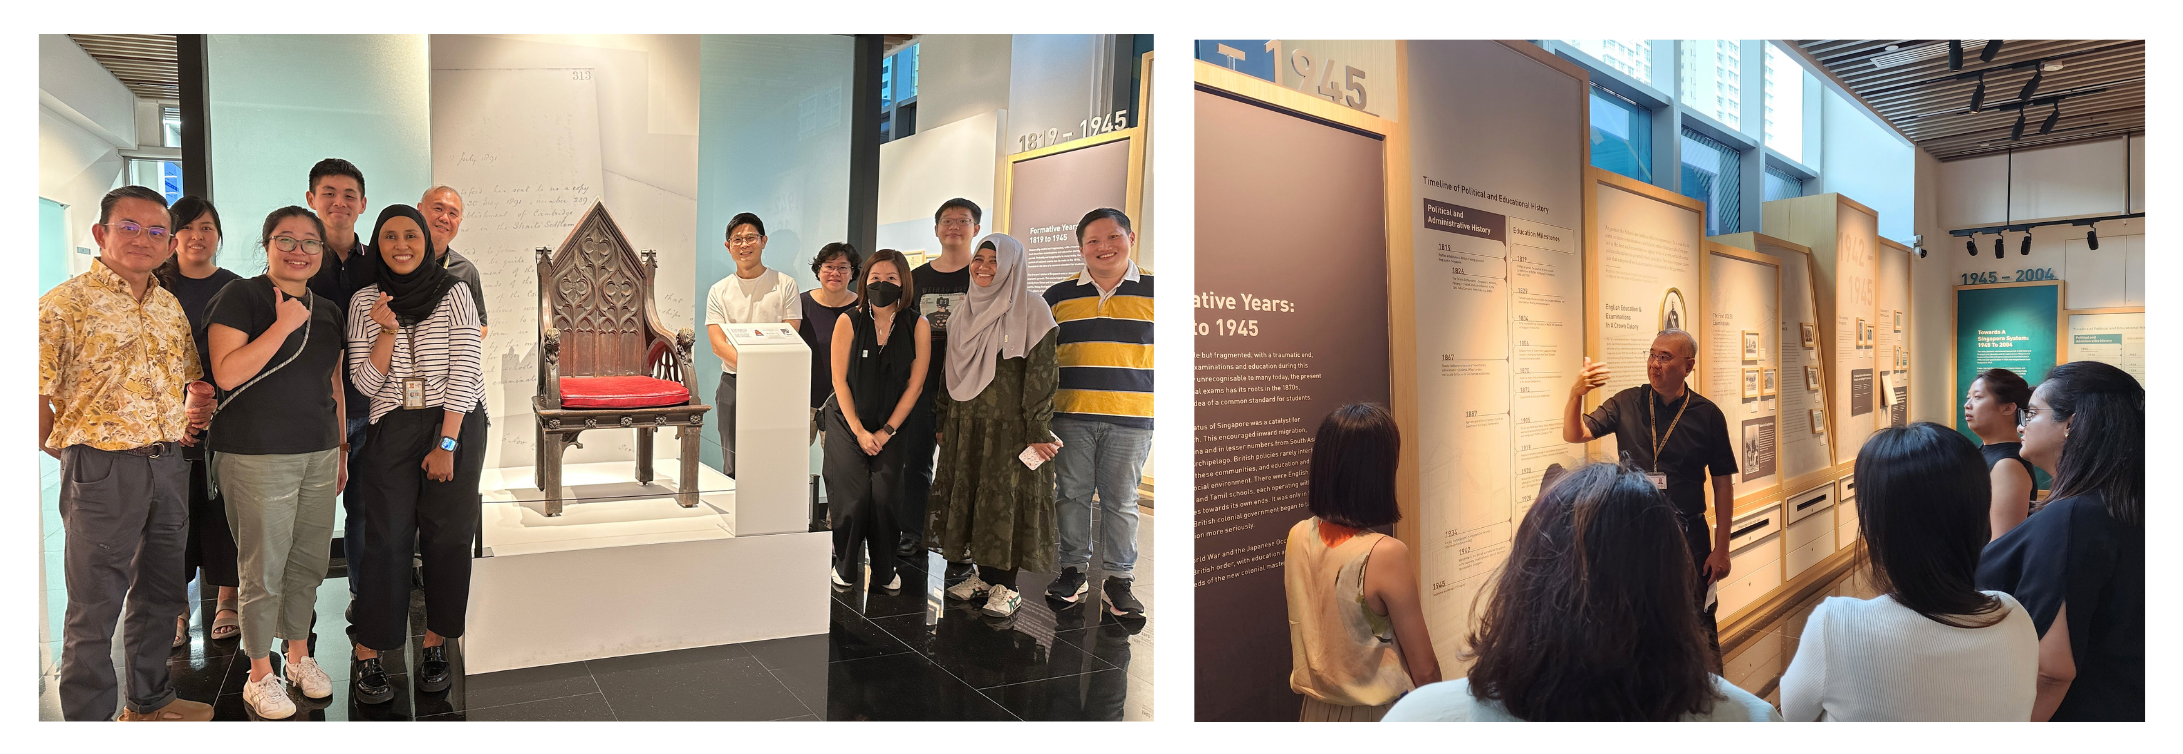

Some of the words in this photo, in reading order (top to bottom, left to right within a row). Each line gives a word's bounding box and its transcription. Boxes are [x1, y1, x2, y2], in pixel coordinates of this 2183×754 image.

[572, 71, 591, 80] 313
[1265, 40, 1367, 110] 1945
[1019, 128, 1058, 152] 1819
[1080, 110, 1126, 138] 1945
[457, 152, 477, 166] July
[481, 154, 497, 163] 1891
[572, 184, 589, 194] copy
[1423, 176, 1452, 190] Timeline
[1454, 184, 1460, 192] of
[1462, 186, 1486, 198] Political
[1487, 193, 1498, 202] and
[1499, 195, 1530, 209] Educational
[1531, 203, 1549, 214] History
[534, 210, 572, 220] Cambridge
[1428, 204, 1452, 216] Political
[1453, 210, 1464, 218] and
[497, 222, 508, 230] the
[1030, 225, 1060, 234] Formative
[1428, 216, 1470, 230] Administrative
[1472, 224, 1491, 235] History
[1513, 226, 1536, 238] Education
[1537, 231, 1560, 243] Milestones
[1840, 232, 1864, 267] 1942
[1962, 271, 1997, 285] 1945
[2016, 268, 2054, 282] 2004
[1849, 275, 1872, 306] 1945
[1241, 293, 1295, 313] Years:
[1216, 319, 1258, 336] 1945
[1214, 352, 1253, 360] fragmented,
[1248, 362, 1277, 370] education
[1197, 373, 1246, 383] unrecognisable
[1273, 373, 1289, 381] today,
[1249, 396, 1275, 404] standard
[1217, 421, 1249, 429] Singapore
[1219, 432, 1256, 440] encouraged
[1226, 444, 1246, 452] lesser
[1247, 441, 1274, 450] numbers
[1234, 454, 1254, 462] British
[1256, 452, 1278, 461] policies
[1215, 466, 1257, 476] communities,
[1271, 461, 1298, 469] education
[1211, 478, 1252, 489] environment.
[1210, 491, 1228, 501] Tamil
[1229, 490, 1255, 498] schools,
[1256, 487, 1271, 495] each
[1272, 482, 1299, 492] operating
[1203, 504, 1229, 513] towards
[1254, 498, 1270, 506] ends.
[1217, 514, 1242, 523] colonial
[1244, 507, 1279, 519] government
[1281, 504, 1297, 512] began
[1206, 529, 1223, 537] more
[1225, 523, 1255, 533] seriously.
[1222, 550, 1234, 558] and
[1247, 541, 1274, 552] Japanese
[1217, 562, 1235, 571] order,
[1237, 558, 1250, 566] with
[1252, 551, 1280, 561] education
[1215, 574, 1225, 582] the
[1241, 566, 1265, 576] colonial
